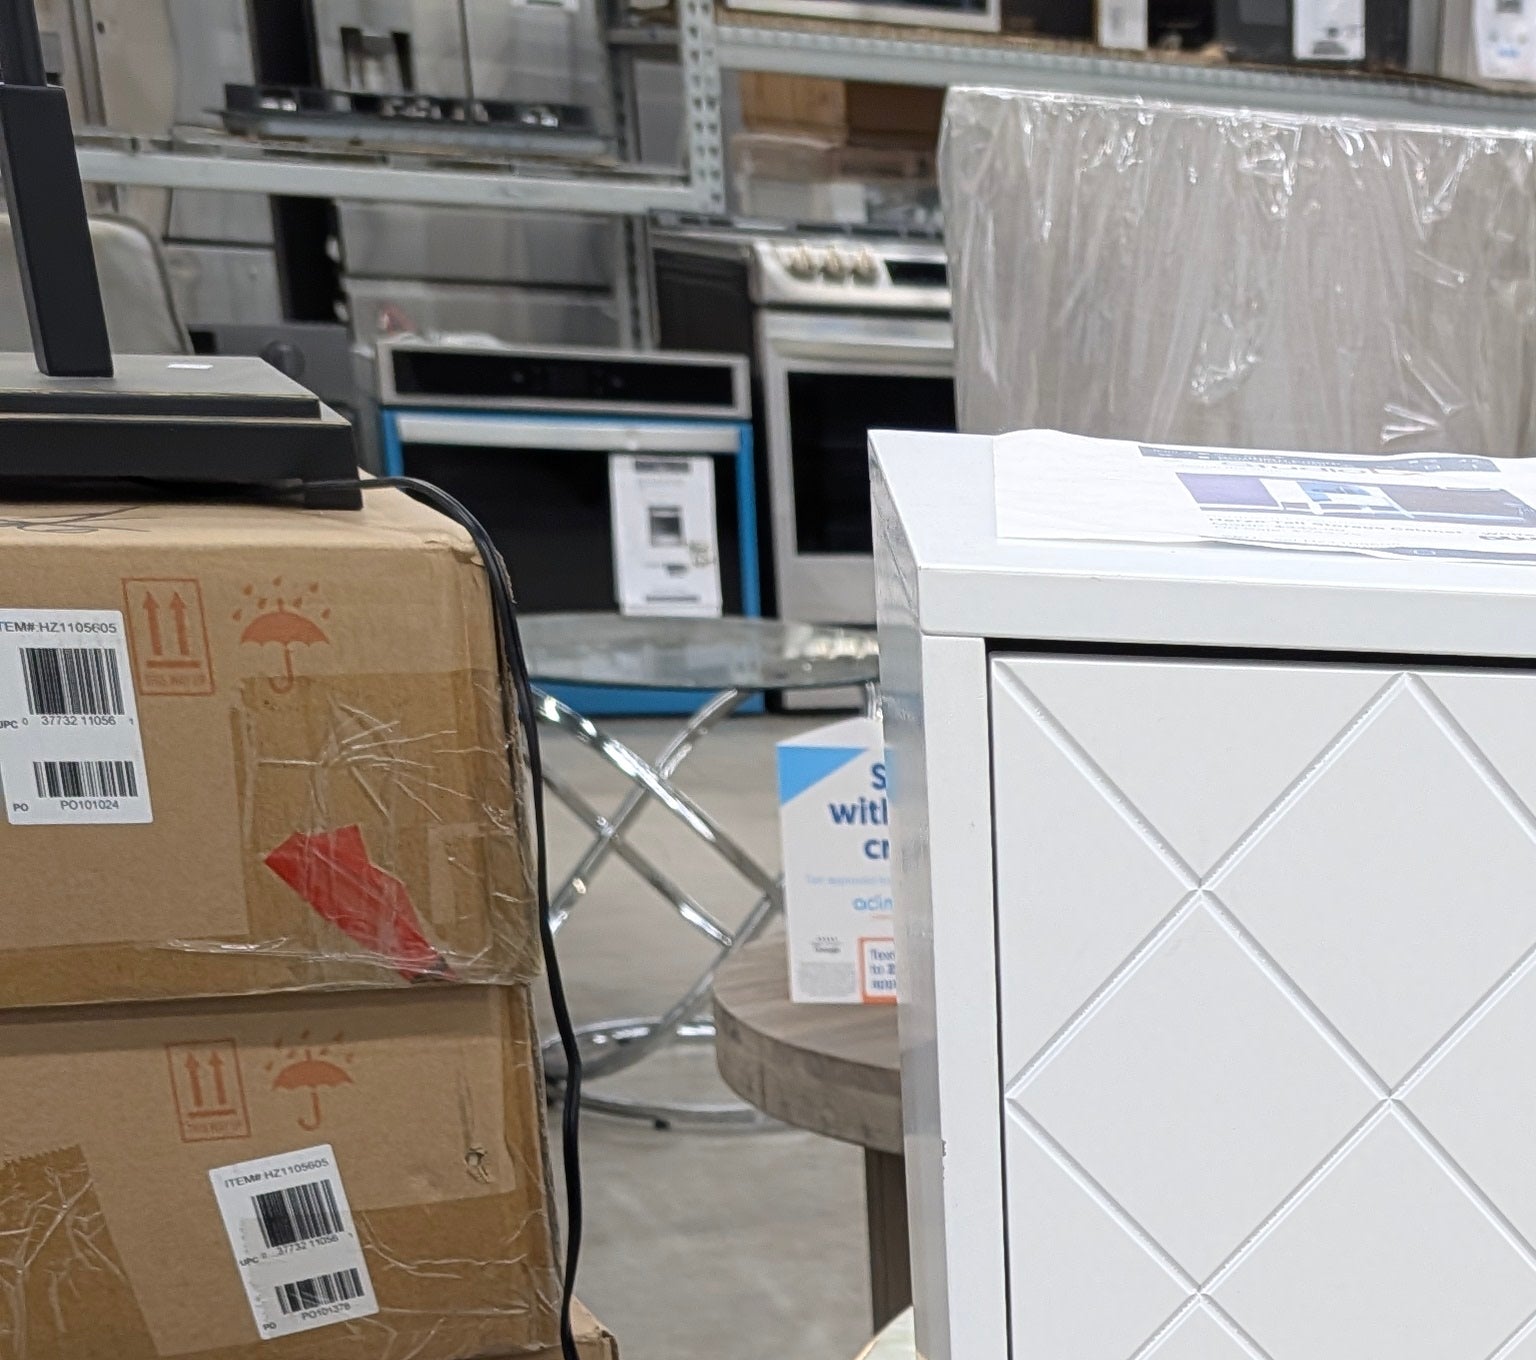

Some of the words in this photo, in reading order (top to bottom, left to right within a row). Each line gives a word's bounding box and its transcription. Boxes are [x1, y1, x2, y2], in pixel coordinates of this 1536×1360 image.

[42, 716, 78, 726] 37732
[82, 716, 116, 726] 11056
[14, 804, 29, 812] PO
[60, 800, 119, 810] PO101024
[262, 1322, 277, 1330] PO
